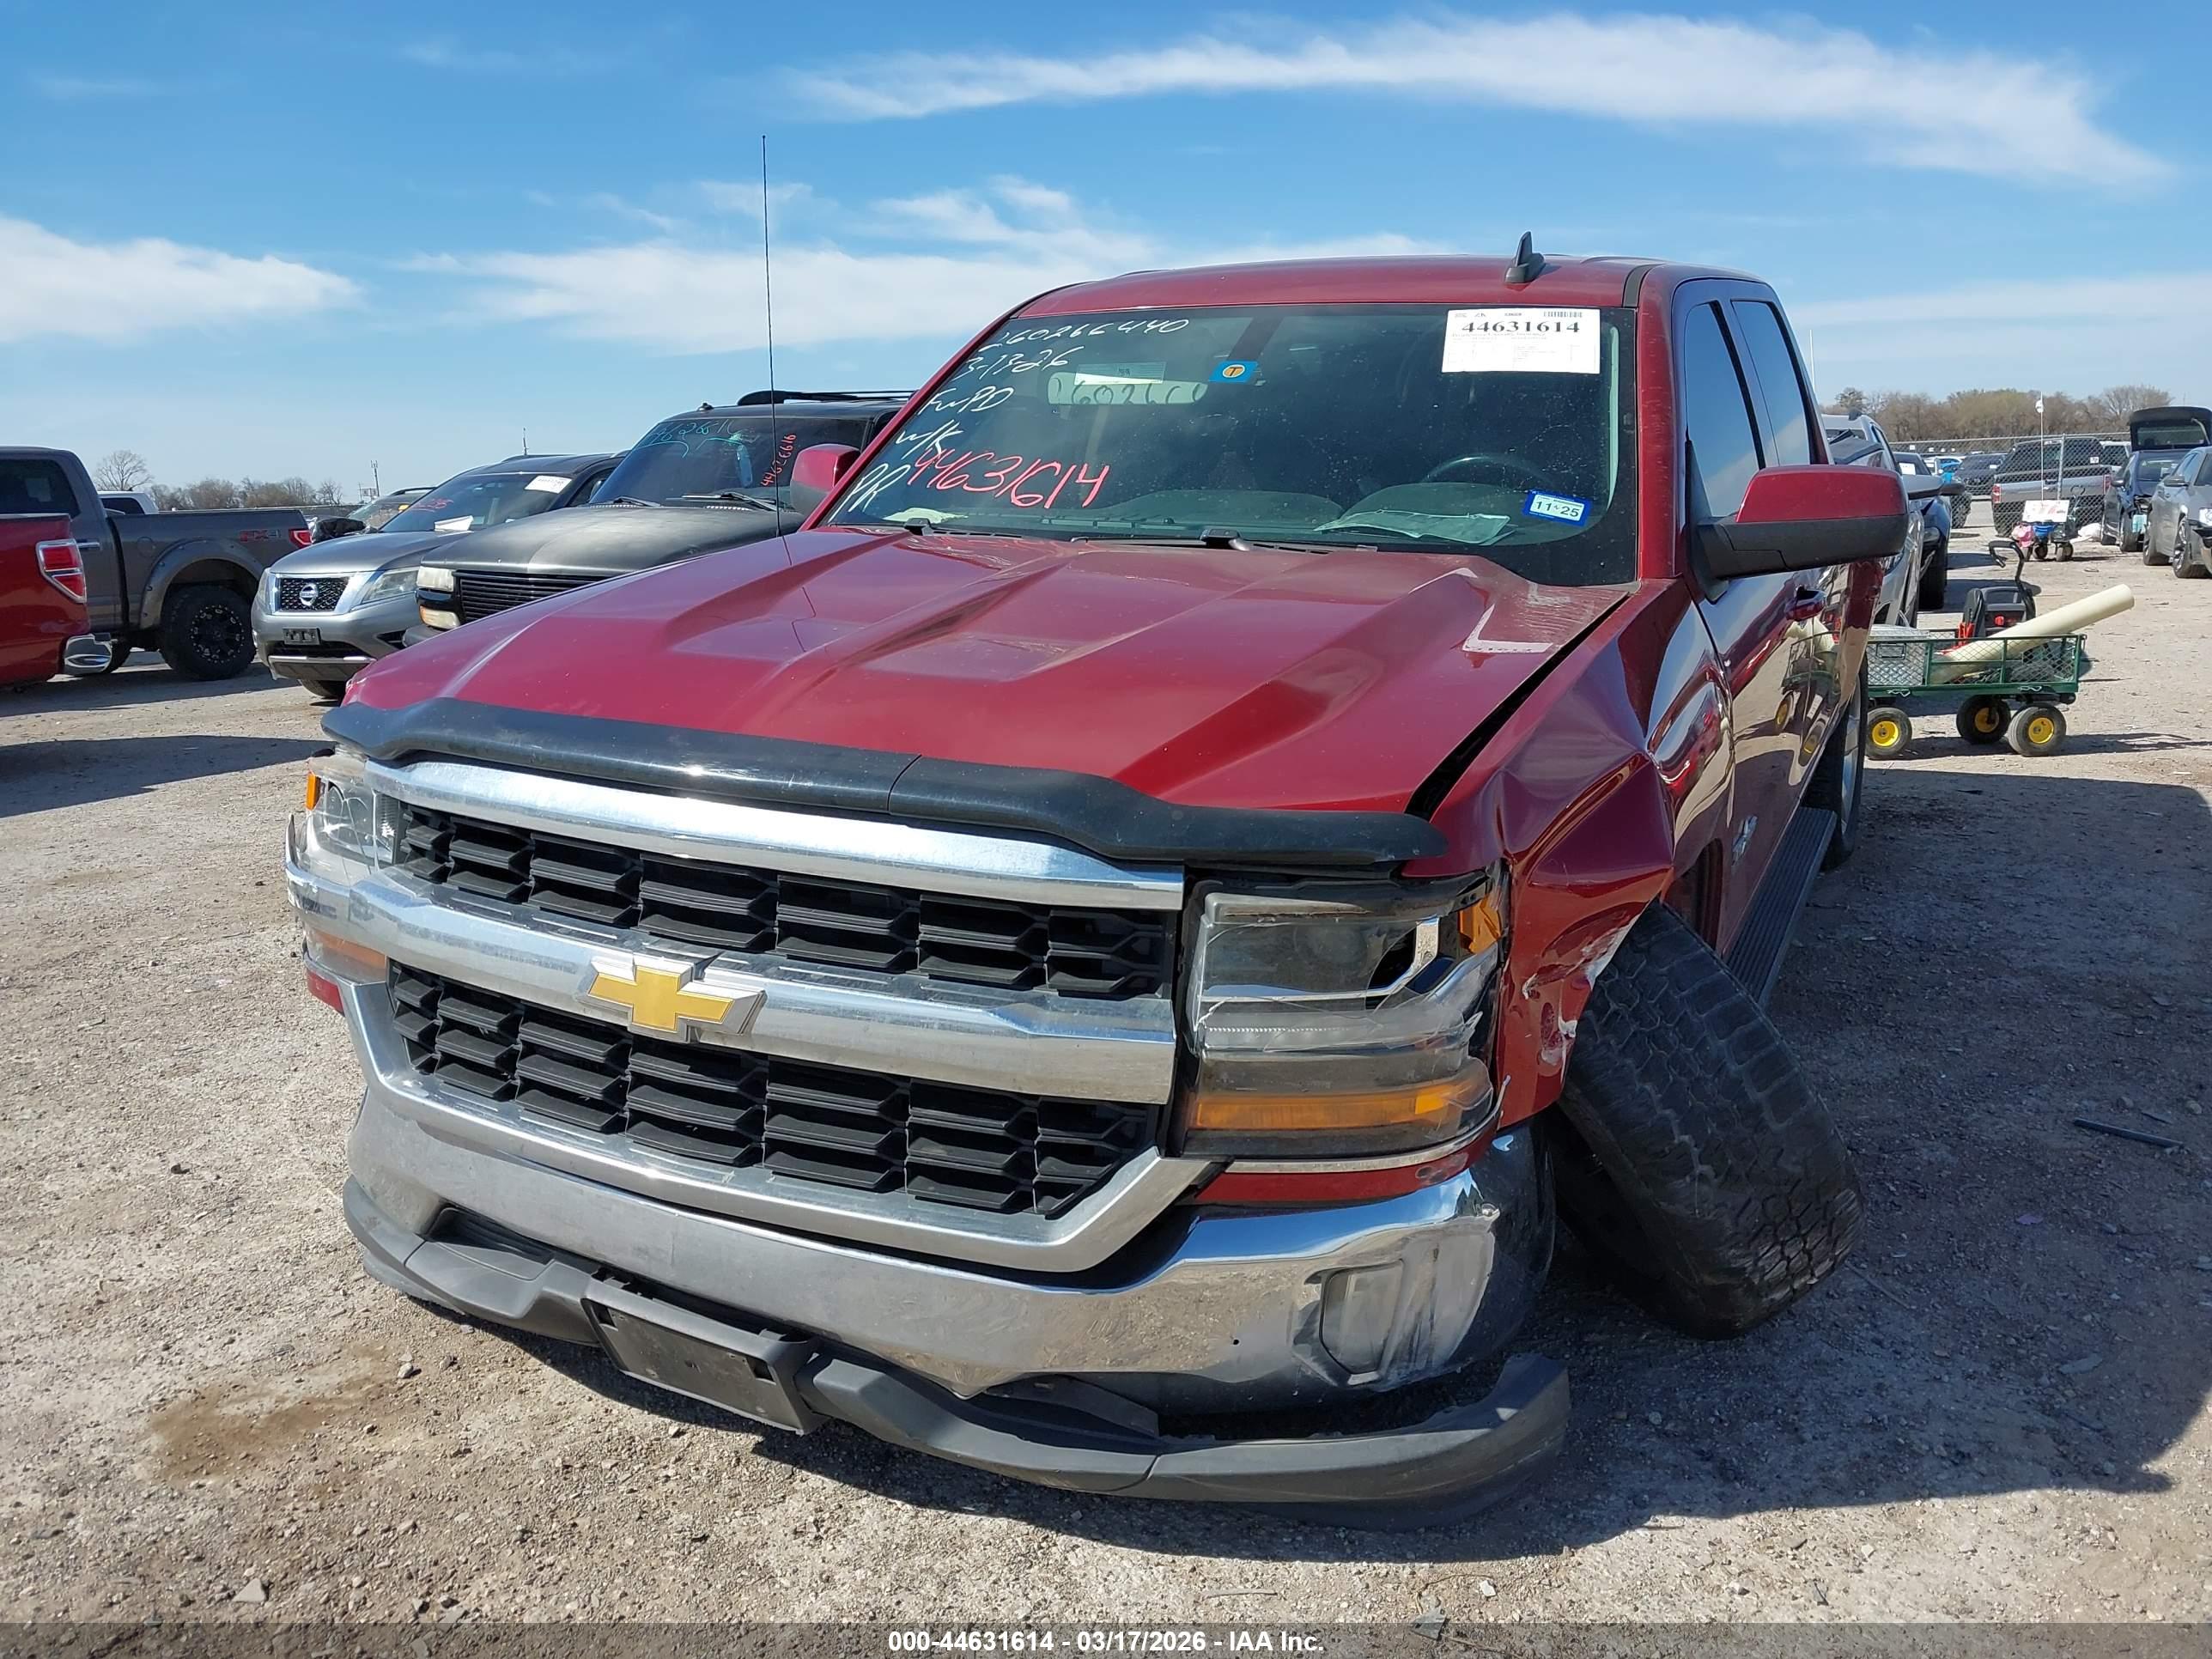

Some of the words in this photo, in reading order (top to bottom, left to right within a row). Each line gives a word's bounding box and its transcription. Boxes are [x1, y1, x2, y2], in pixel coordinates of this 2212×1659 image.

[1462, 321, 1580, 332] 44631614
[908, 447, 1110, 509] 44631614
[1536, 501, 1553, 512] 11
[1559, 506, 1580, 517] 25
